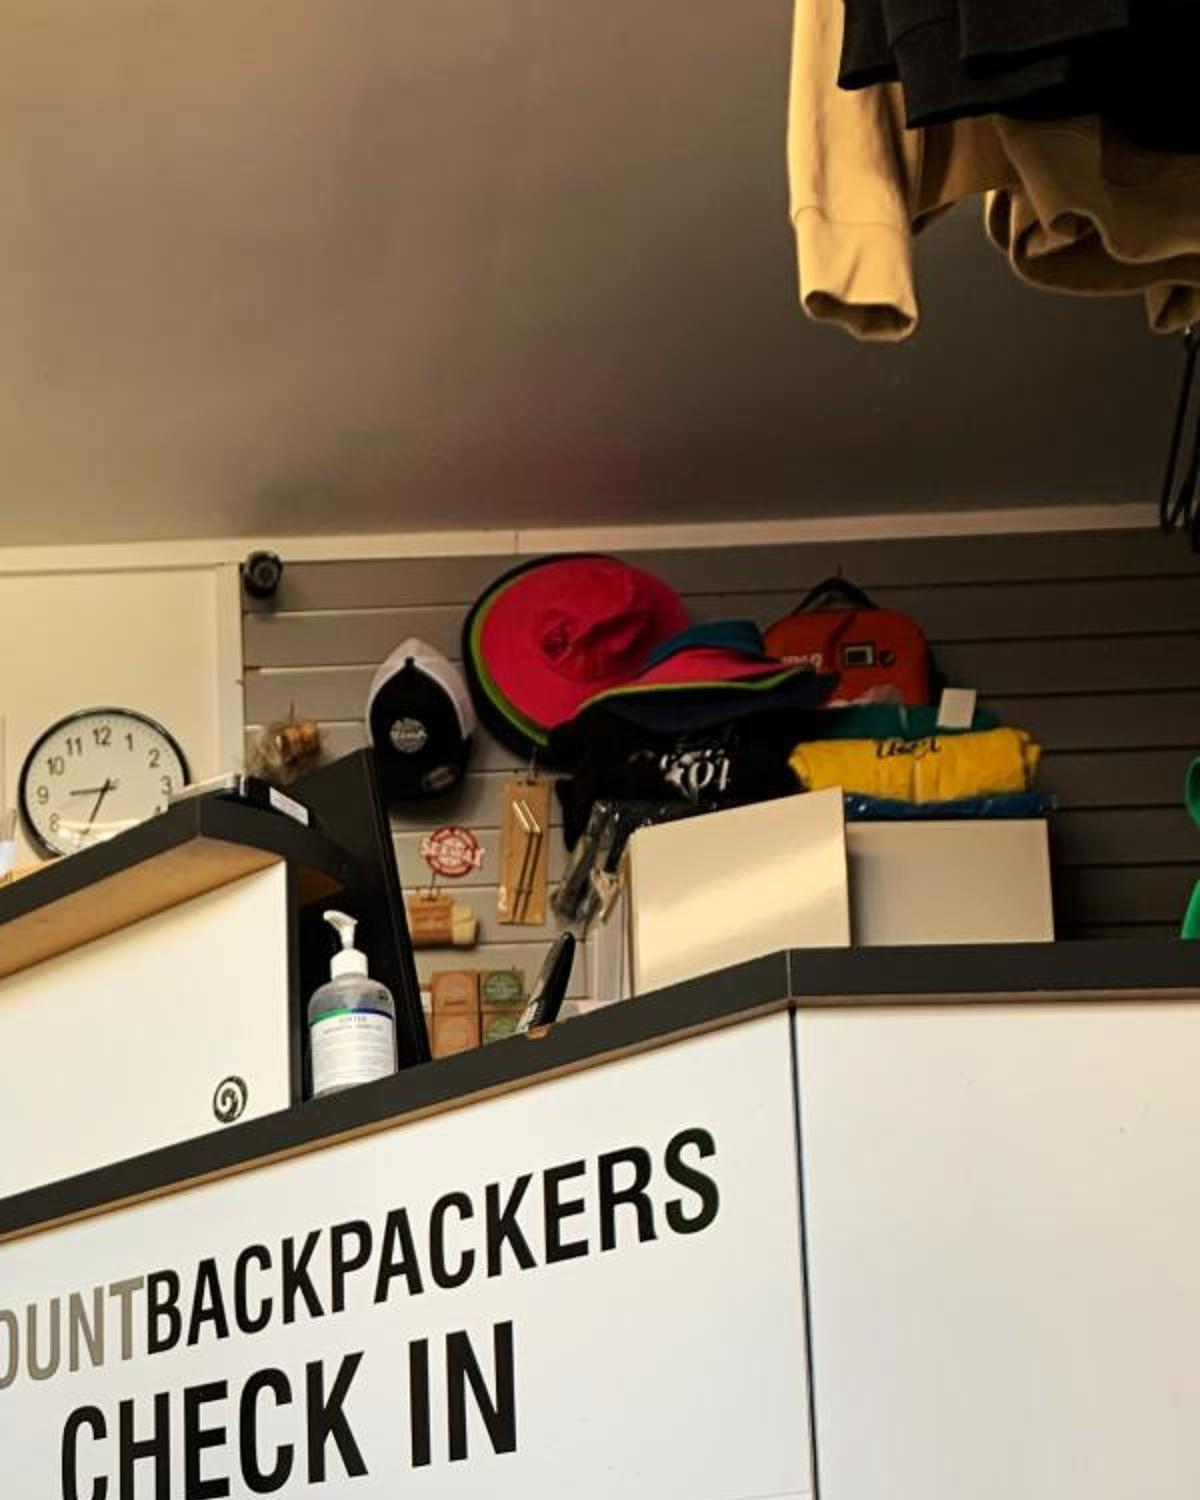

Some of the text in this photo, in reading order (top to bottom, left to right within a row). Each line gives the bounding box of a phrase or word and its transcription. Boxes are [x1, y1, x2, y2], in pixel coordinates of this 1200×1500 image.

[65, 736, 83, 756] 11
[92, 725, 113, 747] 12
[125, 732, 134, 751] 1
[46, 755, 65, 776] 10
[148, 748, 161, 769] 2
[36, 785, 49, 806] 9
[160, 775, 173, 796] 3
[408, 1320, 518, 1468] IN
